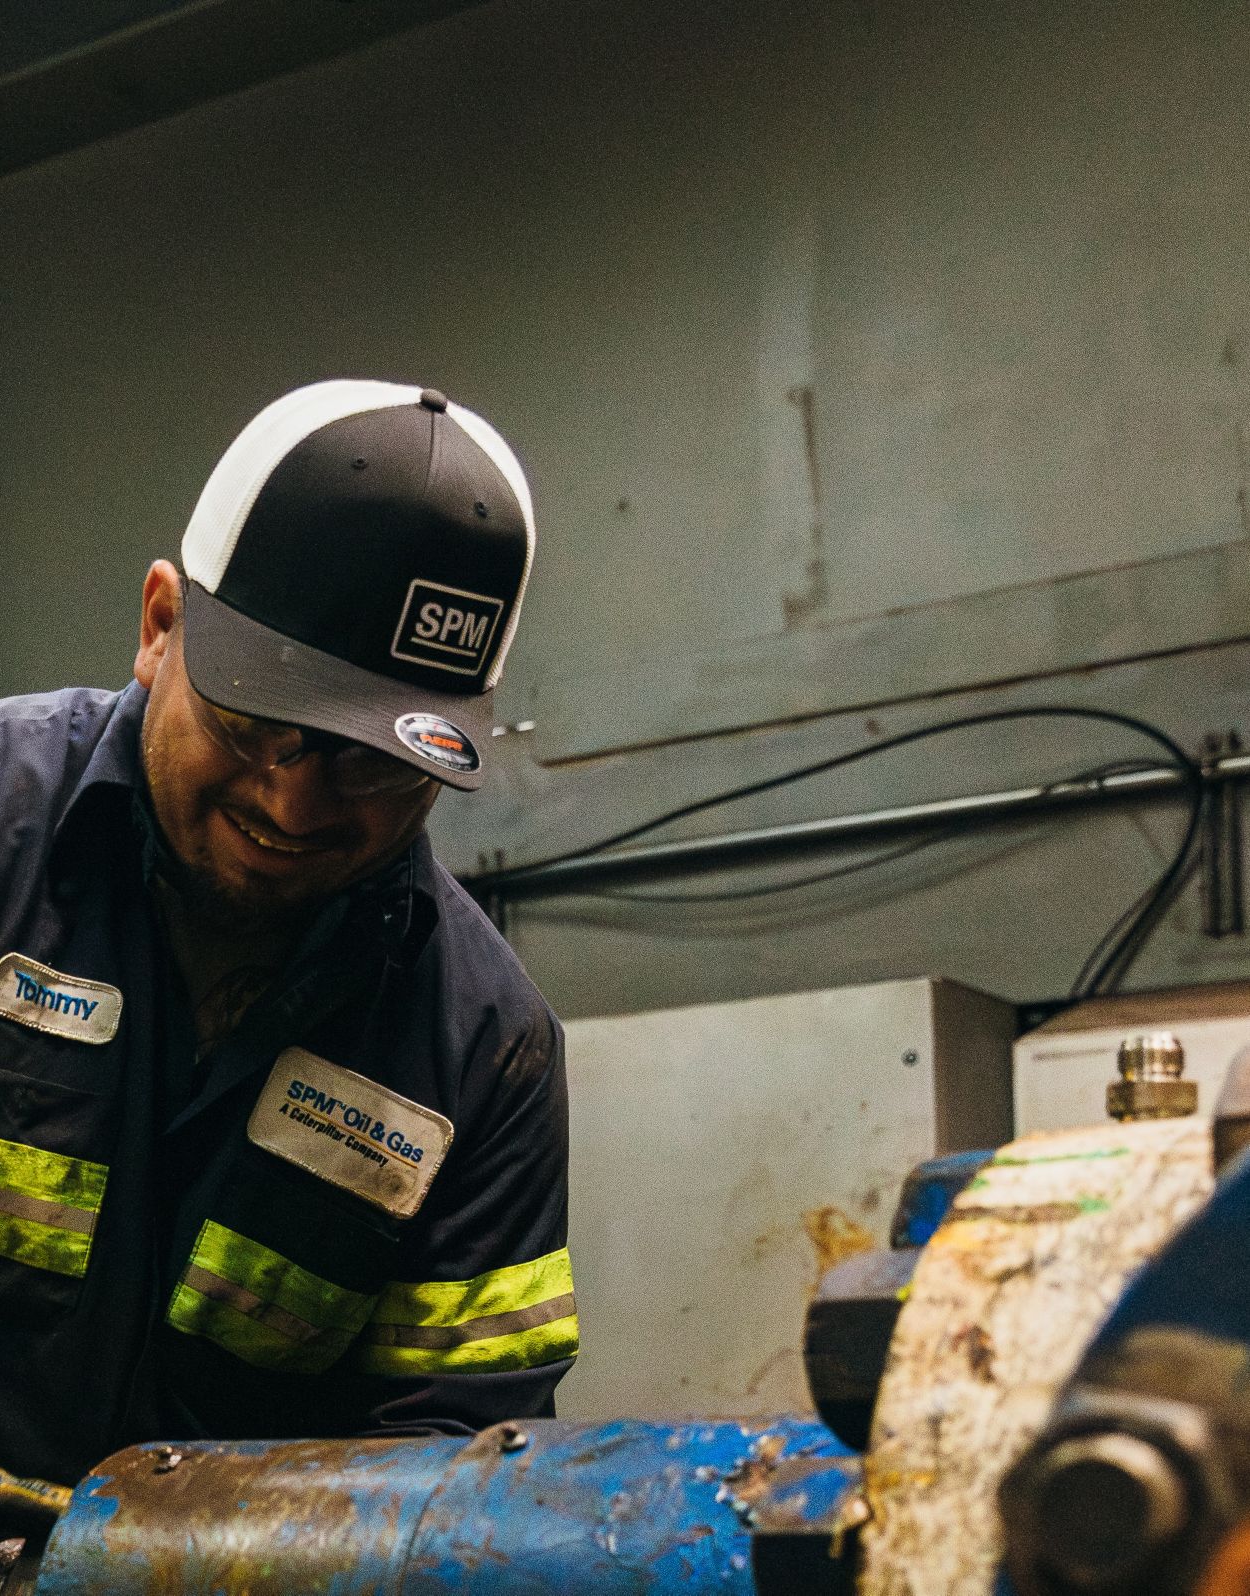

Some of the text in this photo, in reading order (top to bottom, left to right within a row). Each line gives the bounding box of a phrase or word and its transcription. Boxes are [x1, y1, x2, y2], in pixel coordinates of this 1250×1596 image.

[415, 602, 489, 649] SPM
[14, 969, 99, 1021] Tommy
[279, 1103, 390, 1168] A Caterpillar Company
[343, 1107, 372, 1134] Oil
[369, 1121, 386, 1143] &
[386, 1131, 424, 1163] Gas
